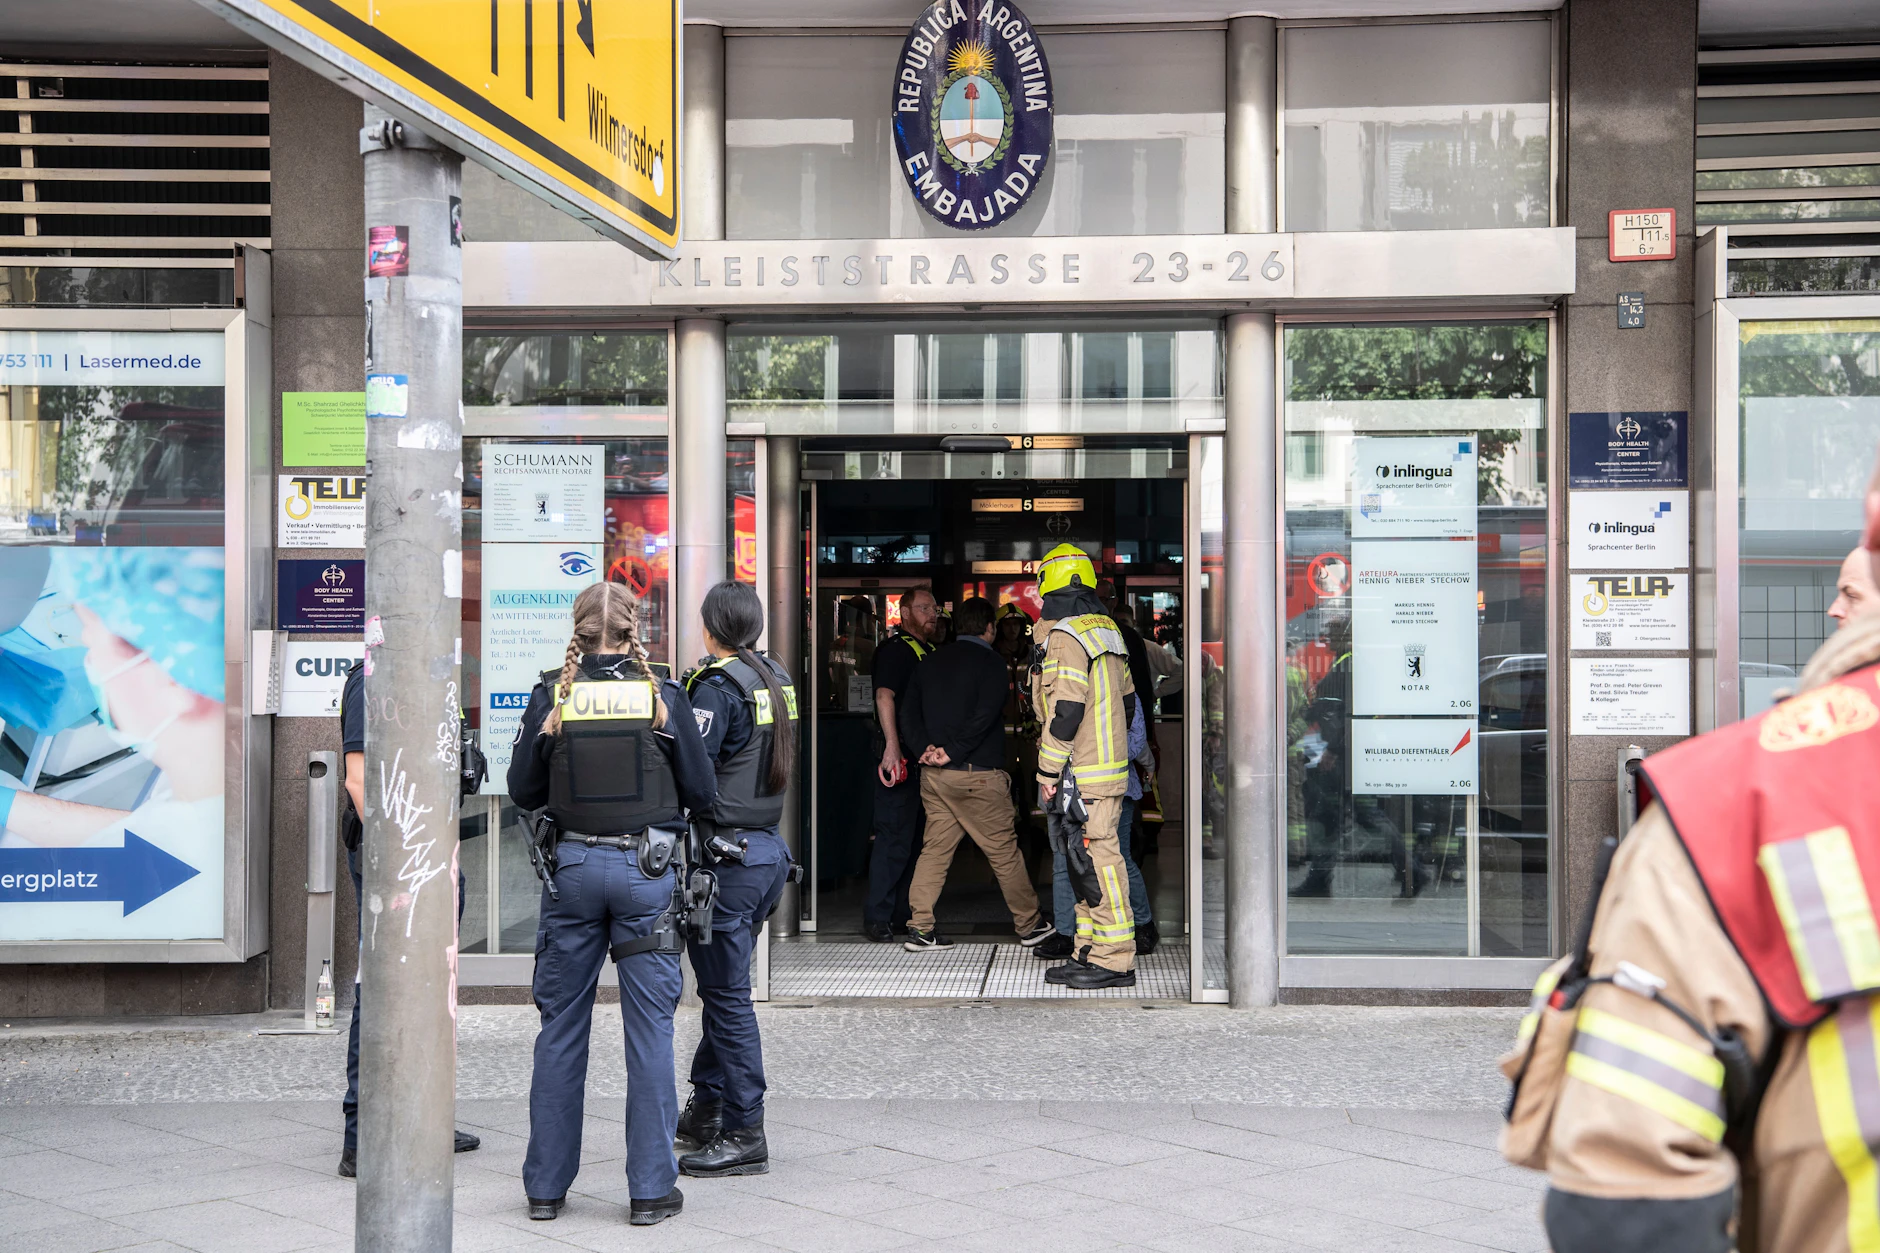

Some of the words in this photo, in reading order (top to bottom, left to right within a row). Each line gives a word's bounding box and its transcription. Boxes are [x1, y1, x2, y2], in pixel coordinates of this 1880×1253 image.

[898, 0, 968, 112] REPUBLICA
[977, 0, 1048, 112] ARGENTINA
[905, 151, 1042, 224] EMBAJADA
[658, 253, 1080, 287] KLEISTSTRASSE
[1132, 250, 1285, 283] 23-26
[1619, 295, 1629, 304] AS
[32, 354, 52, 368] 111
[80, 354, 202, 368] Lasermed.de
[1023, 436, 1032, 448] 6
[494, 454, 592, 466] SCHUMANN
[1394, 464, 1452, 480] inlingua
[1023, 500, 1032, 510] 5
[1604, 522, 1655, 536] inlingua
[1024, 562, 1032, 573] 4
[1587, 576, 1675, 599] TELA
[1025, 625, 1032, 635] 3
[0, 869, 98, 892] ergplatz
